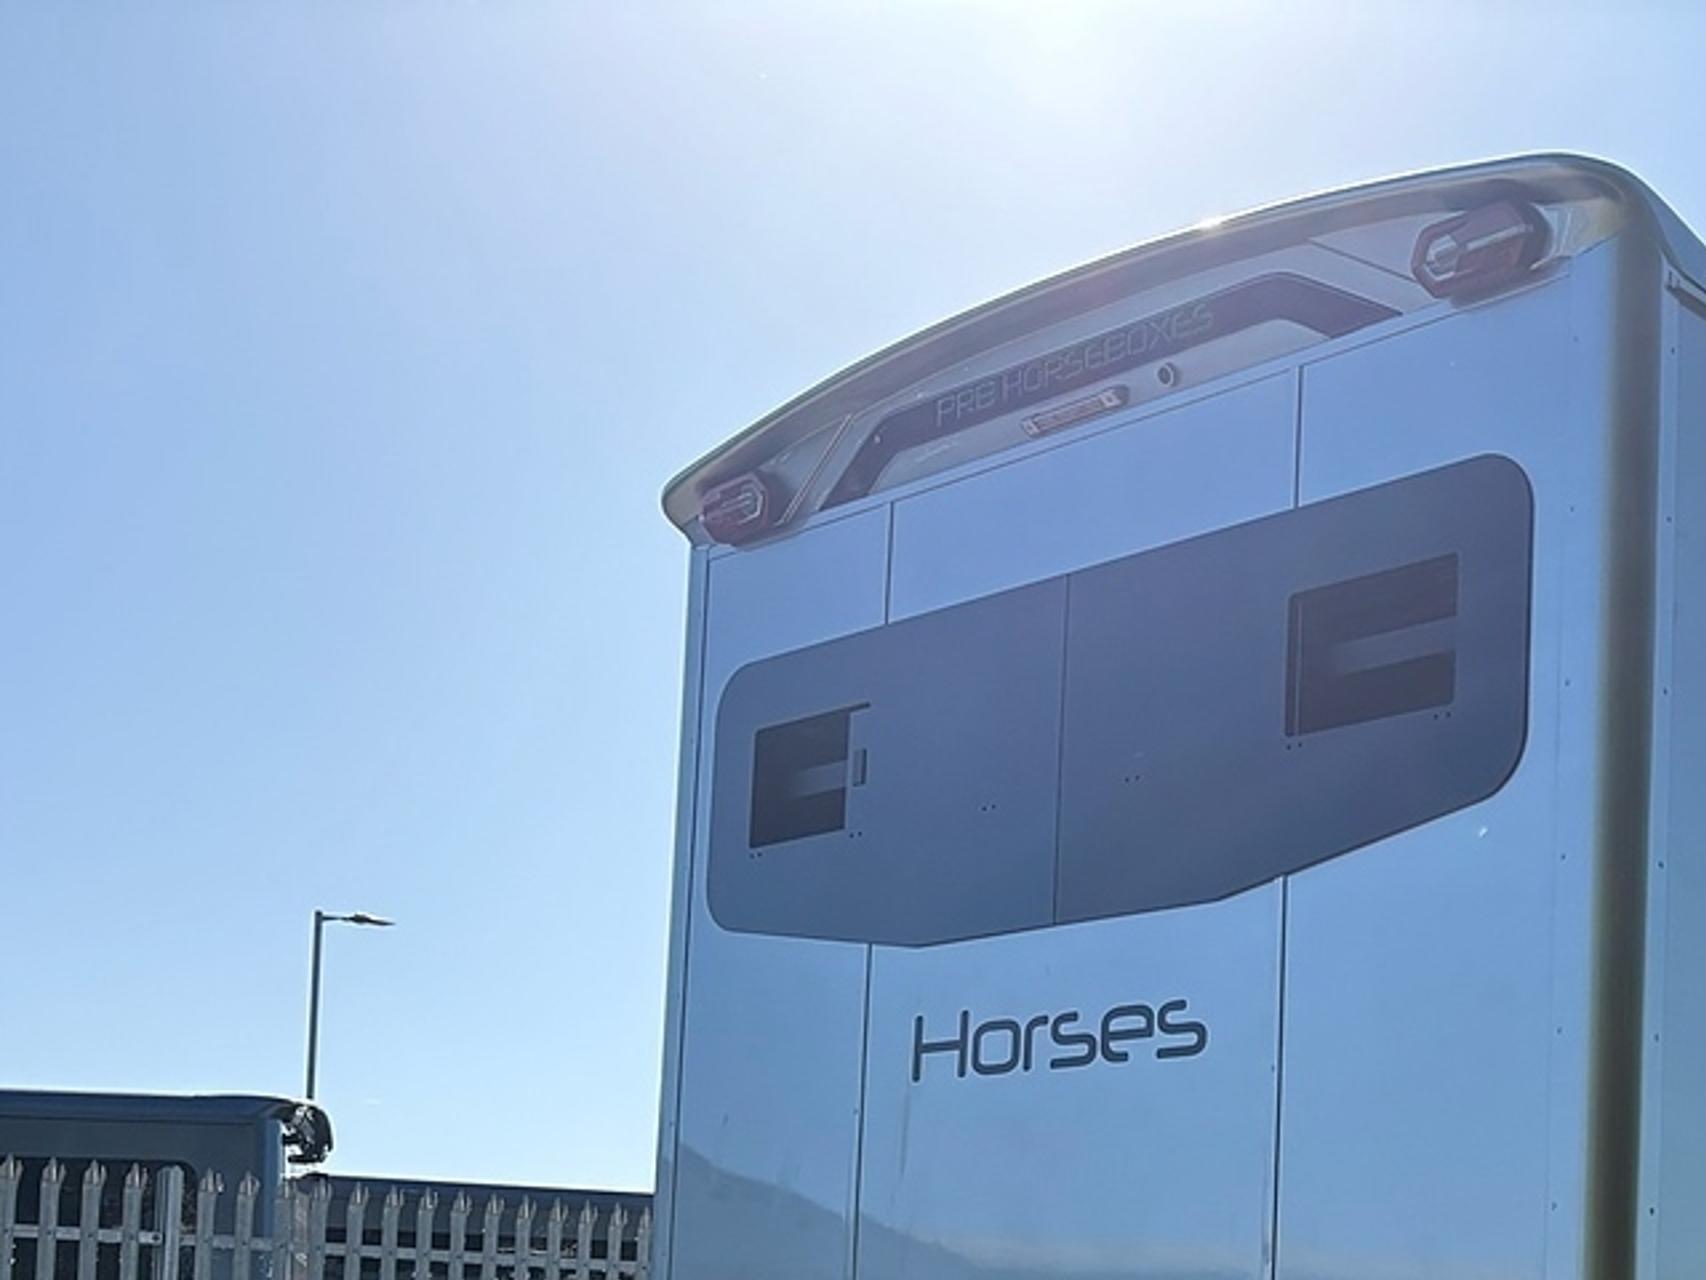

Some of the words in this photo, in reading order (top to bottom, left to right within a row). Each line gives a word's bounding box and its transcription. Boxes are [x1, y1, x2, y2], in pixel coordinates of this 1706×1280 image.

[935, 379, 997, 427] PRB
[1002, 302, 1215, 402] HORSEBOXES
[910, 998, 1209, 1083] Horses
